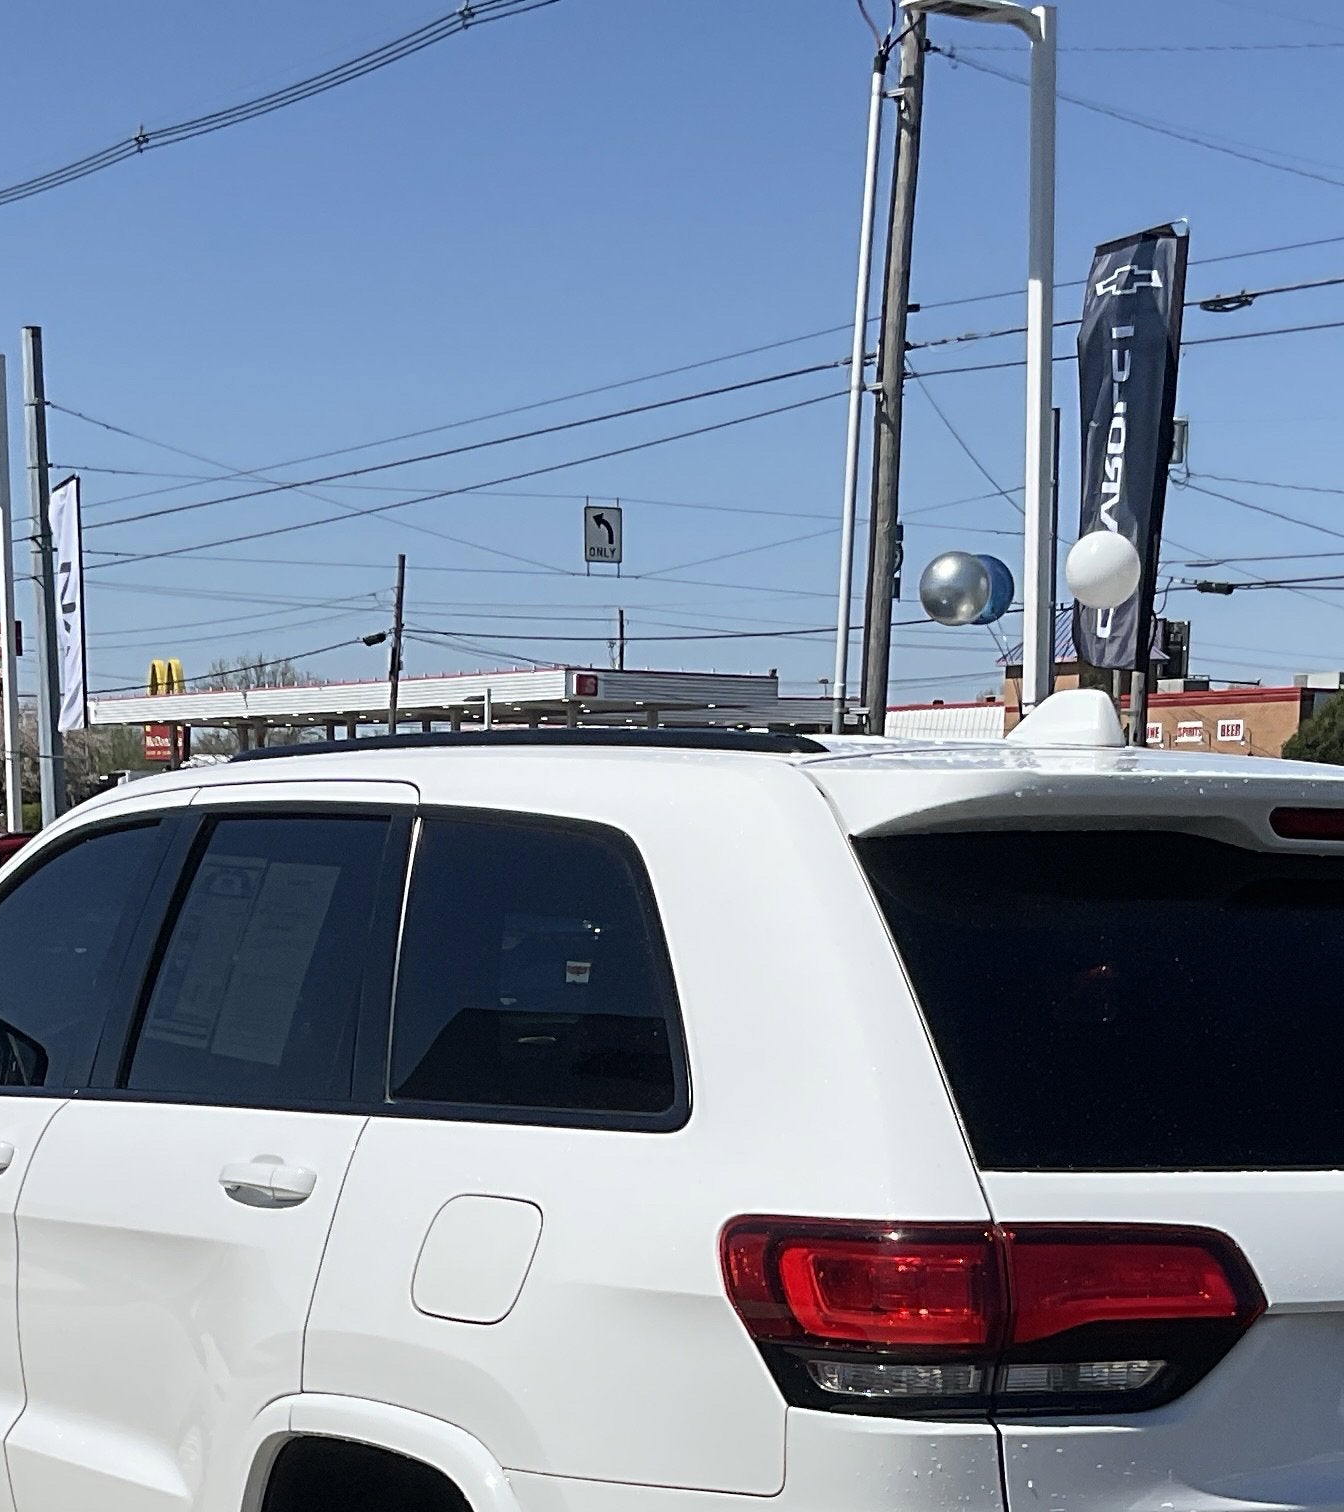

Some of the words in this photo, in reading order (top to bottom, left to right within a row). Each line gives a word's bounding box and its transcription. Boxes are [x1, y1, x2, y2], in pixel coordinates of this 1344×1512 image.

[589, 546, 617, 558] ONLY
[1147, 726, 1160, 738] INE
[1177, 726, 1203, 738] SPIRITS
[1220, 724, 1241, 737] BEER
